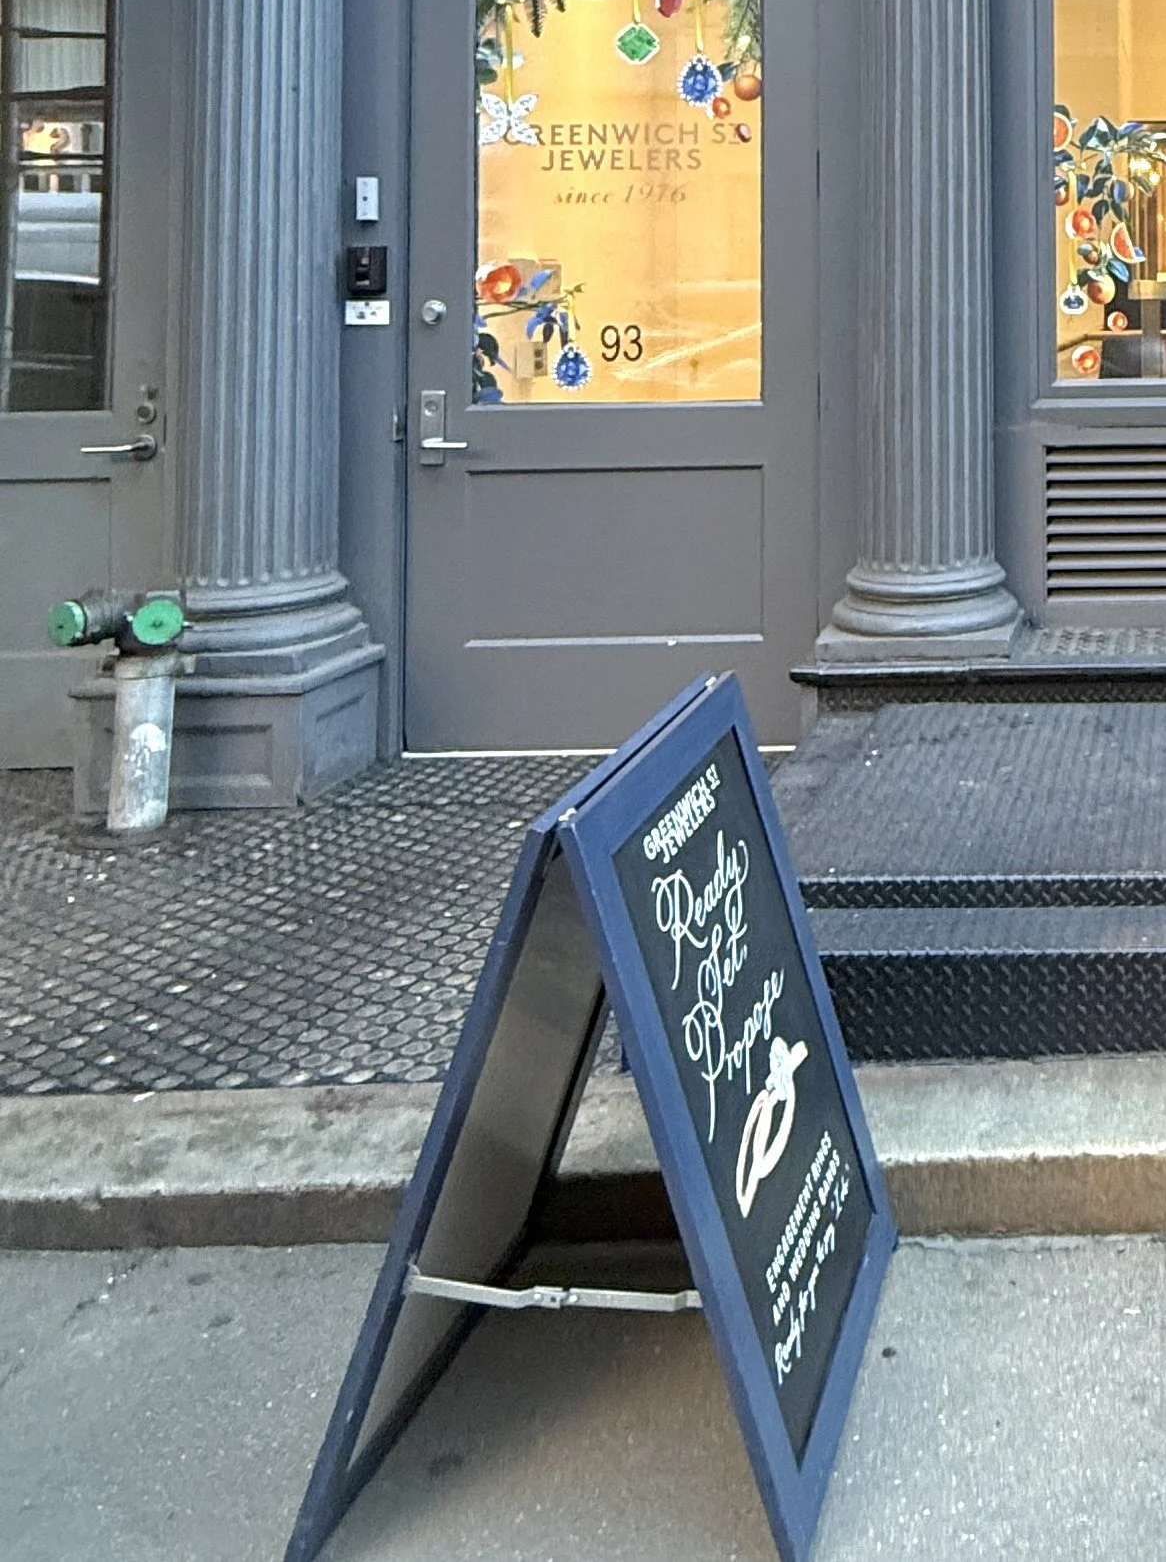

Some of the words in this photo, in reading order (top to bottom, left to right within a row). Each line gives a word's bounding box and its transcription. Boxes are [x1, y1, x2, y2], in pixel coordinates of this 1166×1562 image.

[541, 148, 702, 171] JEWELERS
[554, 185, 614, 204] since
[624, 183, 687, 204] 1976
[600, 325, 643, 362] 93
[643, 776, 709, 861] GREENWICH
[663, 793, 716, 864] JEWELERS
[651, 829, 748, 990] Ready
[682, 967, 785, 1143] Propose
[766, 1172, 813, 1294] ENGAGEMENT
[811, 1130, 832, 1182] RINGS
[772, 1281, 791, 1327] AND
[789, 1200, 821, 1282] WEDDING
[818, 1148, 840, 1206] BANDS
